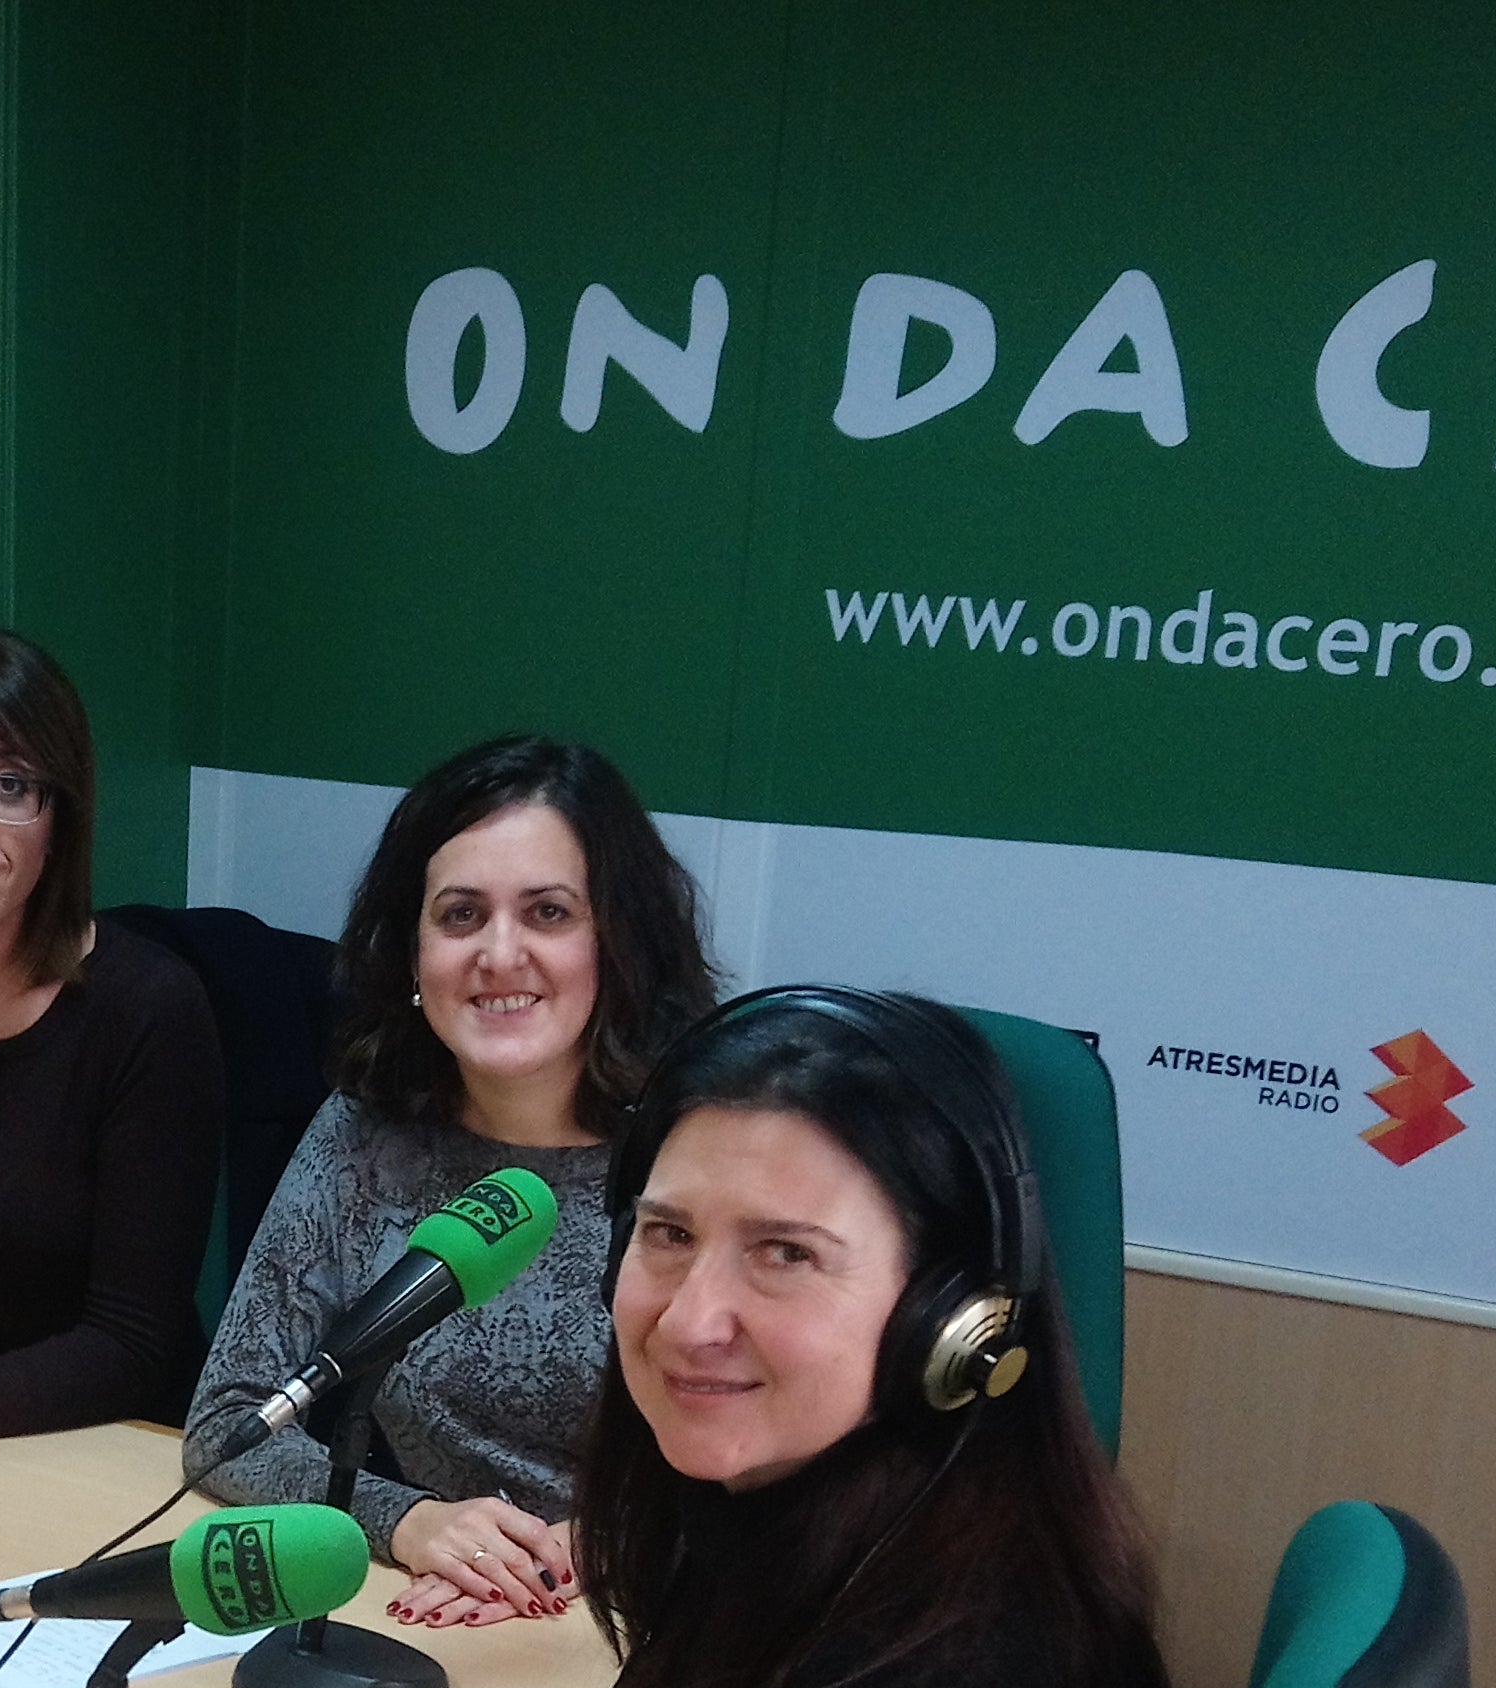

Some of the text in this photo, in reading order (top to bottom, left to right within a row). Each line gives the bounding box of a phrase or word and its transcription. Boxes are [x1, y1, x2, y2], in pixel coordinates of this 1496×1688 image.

[1146, 1045, 1340, 1091] ATRESMEDIA
[1258, 1087, 1340, 1114] RADIO
[474, 1186, 512, 1216] NDA
